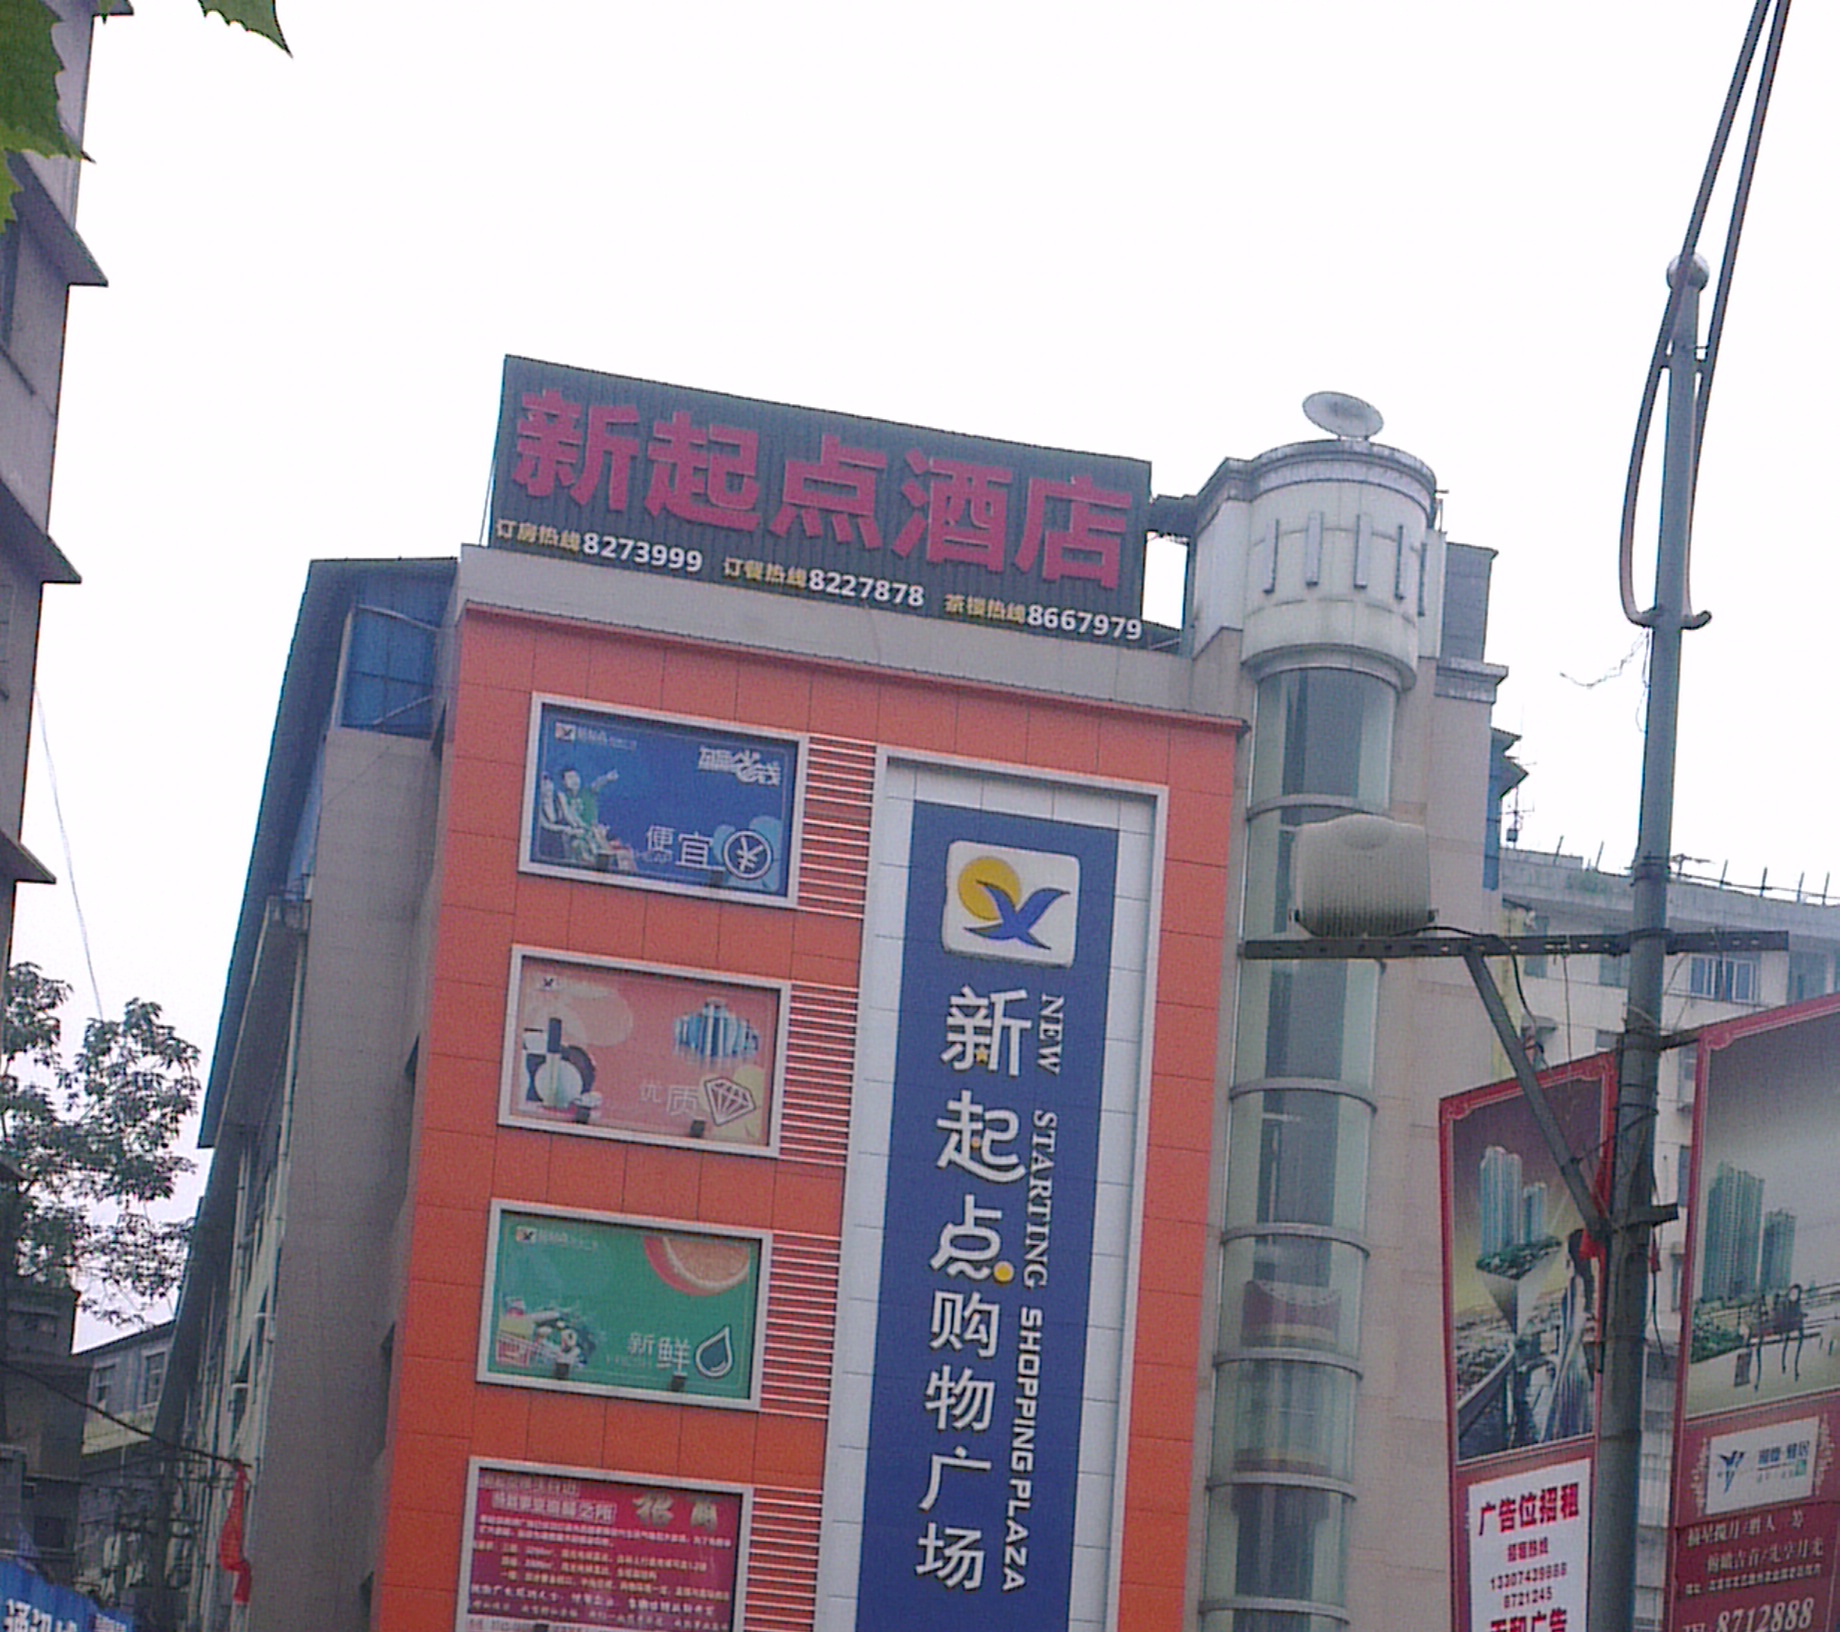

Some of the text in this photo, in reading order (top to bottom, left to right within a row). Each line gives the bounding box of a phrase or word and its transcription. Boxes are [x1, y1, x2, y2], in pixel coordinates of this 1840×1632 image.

[511, 389, 1134, 590] 新起点酒店
[646, 825, 725, 874] 便宜
[915, 984, 1032, 1592] 新起点购物广场
[1002, 993, 1065, 1591] NEW STARTING SHOPPING PLAZA
[628, 1331, 691, 1376] 新鲜
[1479, 1482, 1579, 1536] 广告位招租
